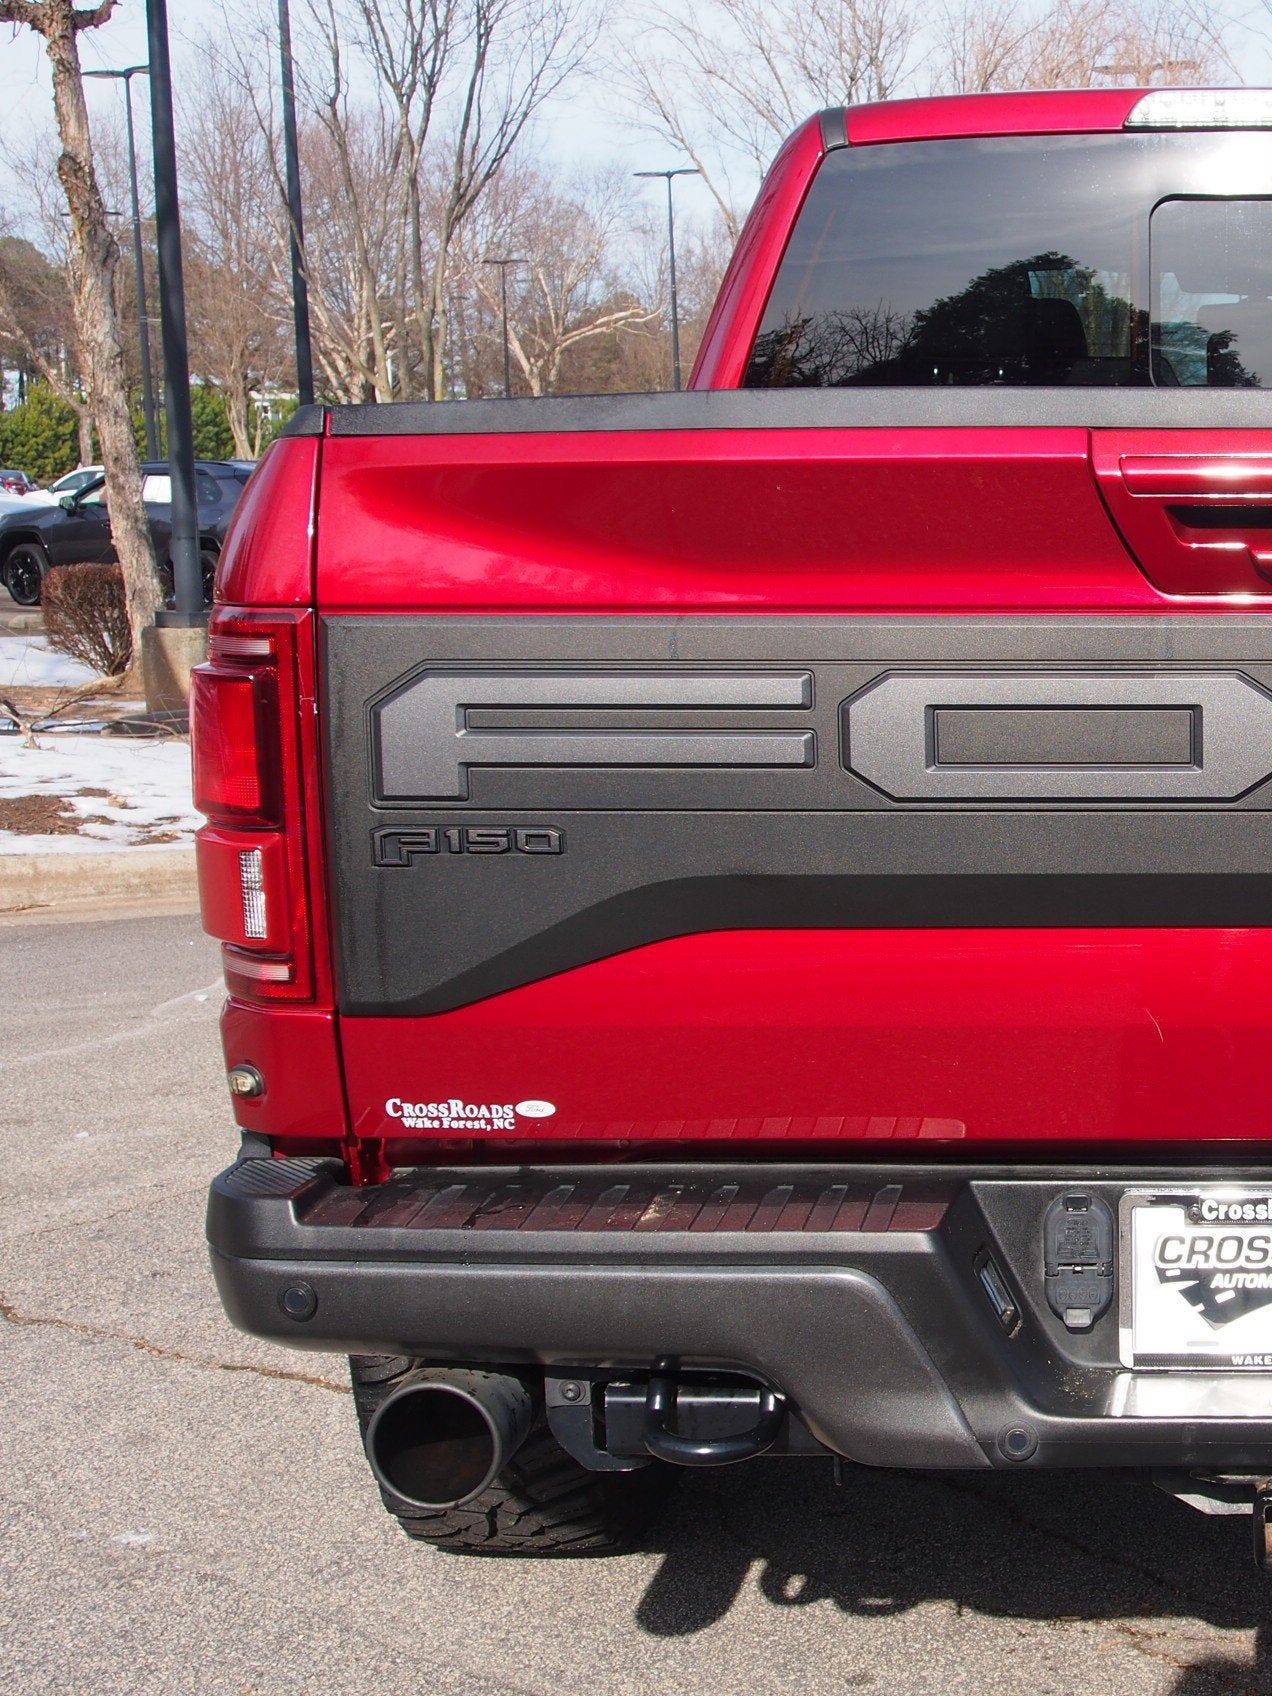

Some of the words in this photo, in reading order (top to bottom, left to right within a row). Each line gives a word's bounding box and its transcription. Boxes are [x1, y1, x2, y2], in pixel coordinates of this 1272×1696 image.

[401, 1118, 440, 1129] Wake
[442, 1118, 491, 1131] Forest,
[492, 1118, 515, 1130] NC
[1231, 1355, 1272, 1365] WAKE
